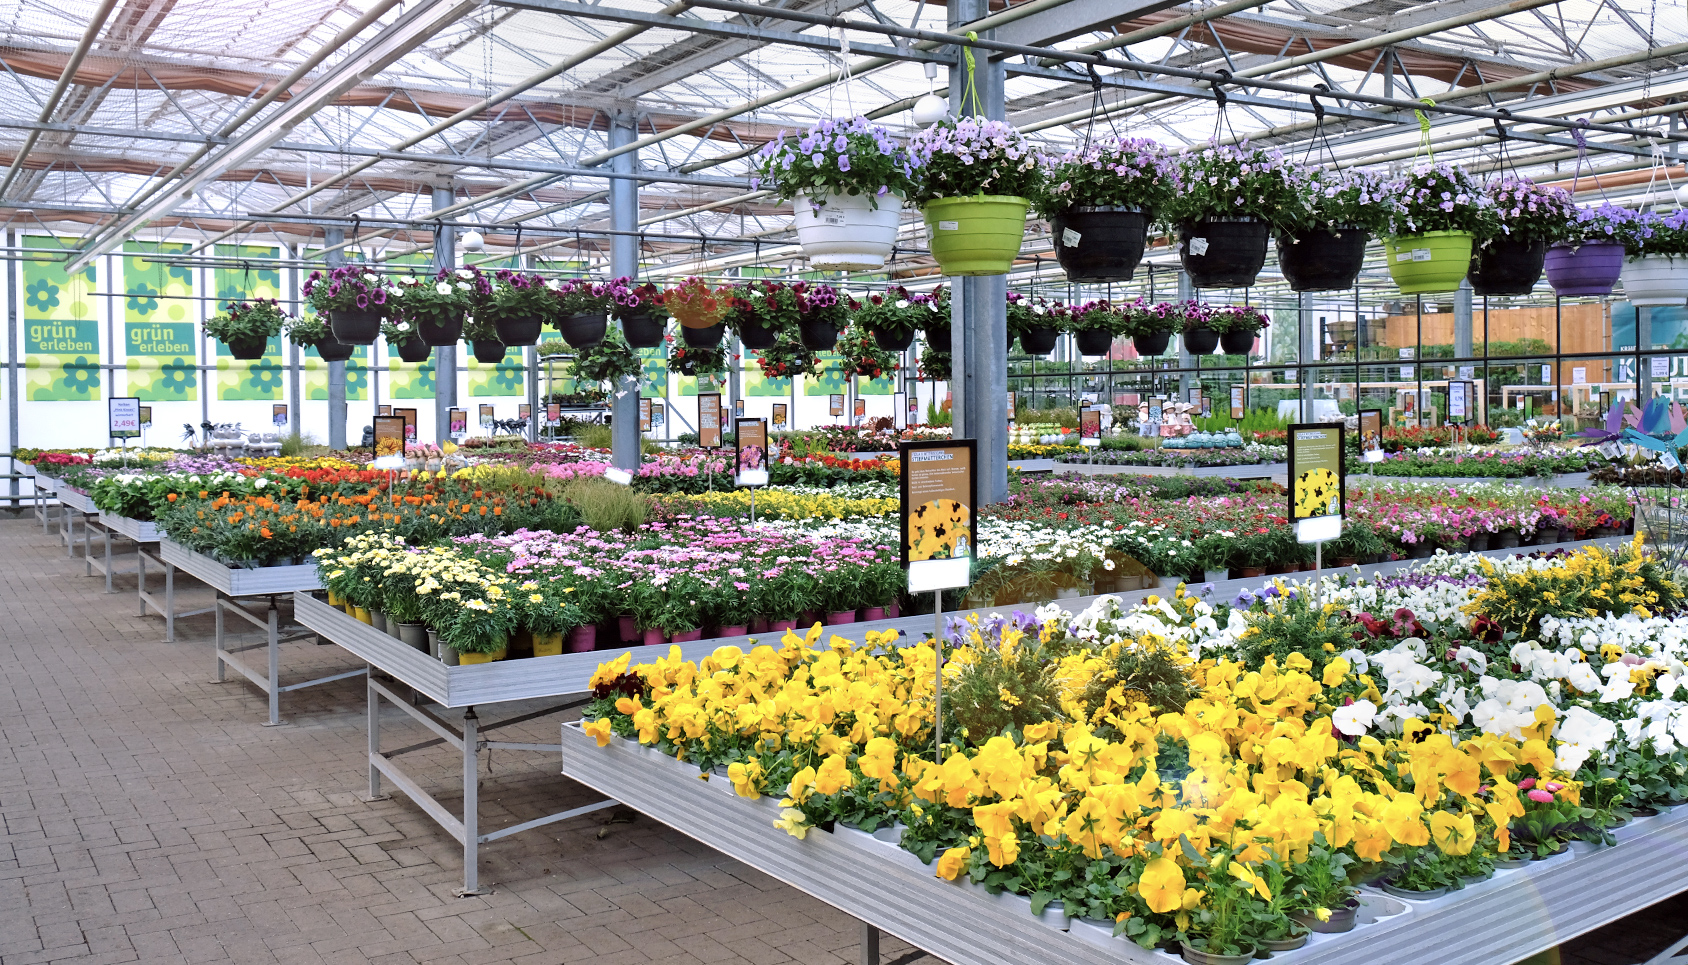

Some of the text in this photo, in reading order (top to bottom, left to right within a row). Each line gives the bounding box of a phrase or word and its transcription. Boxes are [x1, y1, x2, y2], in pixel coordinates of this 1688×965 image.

[30, 321, 76, 342] grün
[130, 324, 174, 345] grün
[39, 339, 92, 350] erleben
[139, 341, 189, 352] erleben
[113, 419, 136, 428] 2,49€
